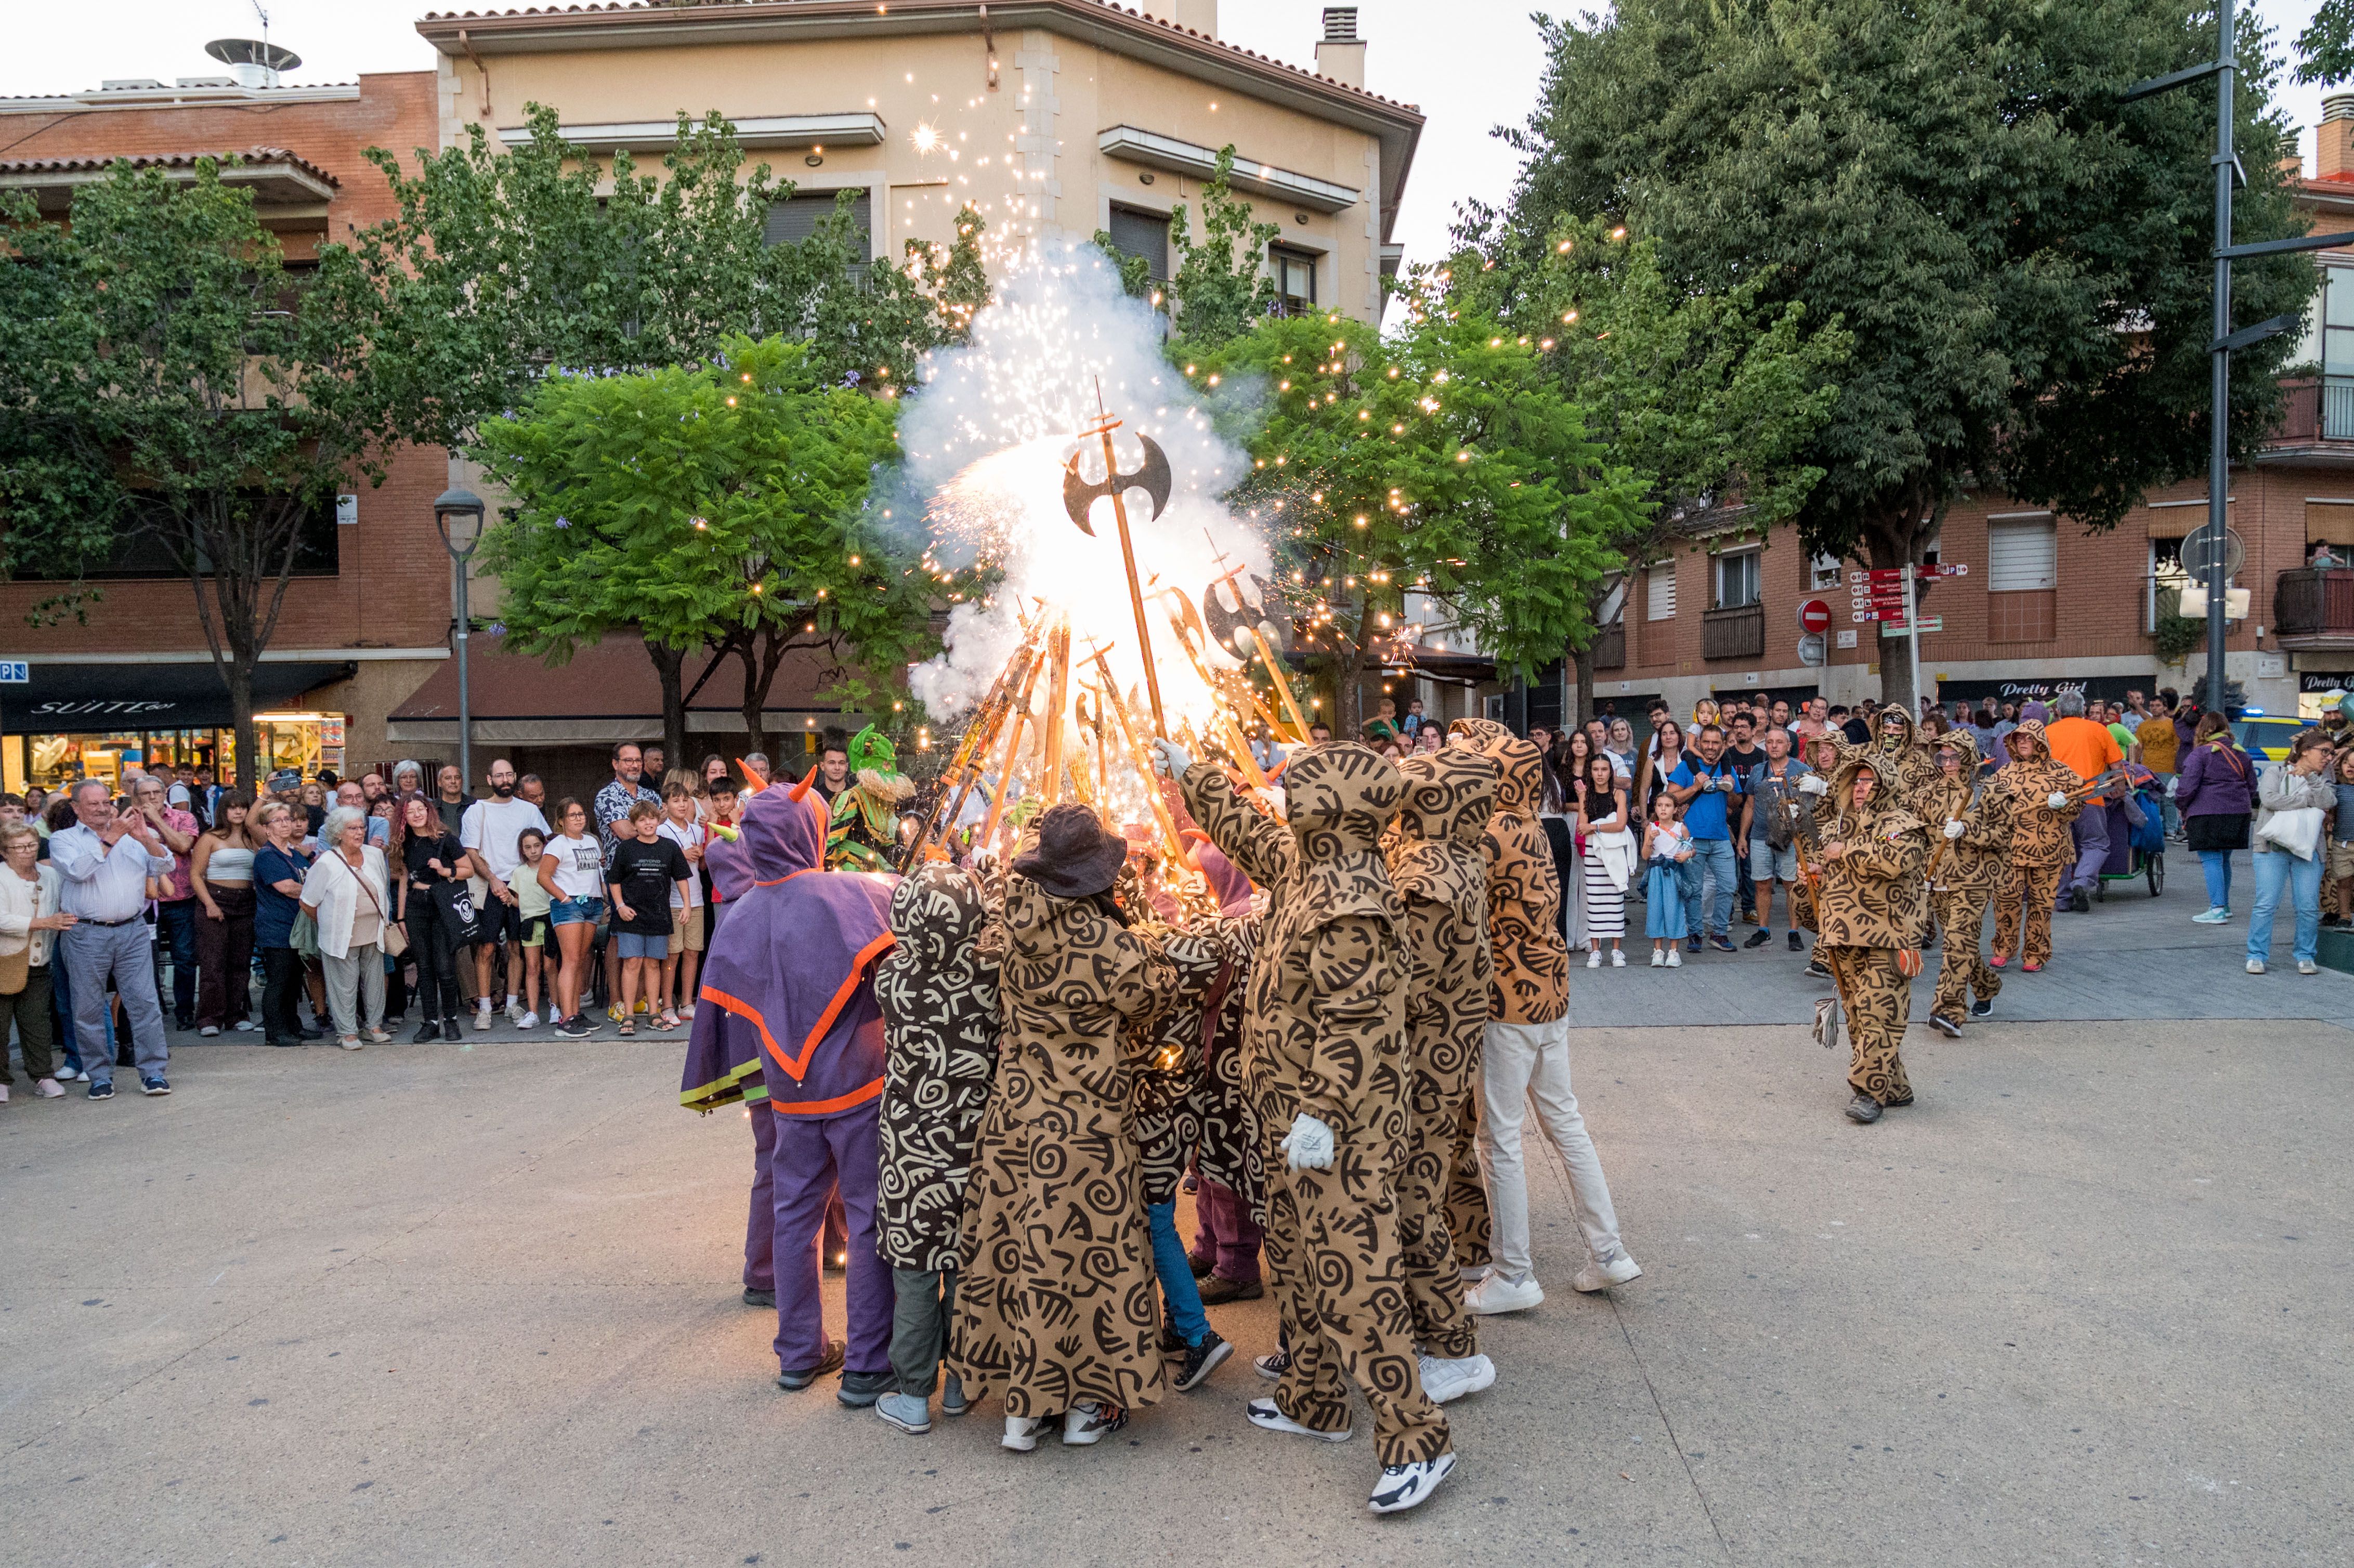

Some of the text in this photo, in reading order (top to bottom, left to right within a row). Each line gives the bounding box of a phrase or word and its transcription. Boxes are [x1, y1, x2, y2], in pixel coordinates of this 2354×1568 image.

[2000, 681, 2087, 697] Pretty Girl
[2305, 675, 2341, 689] Pretty
